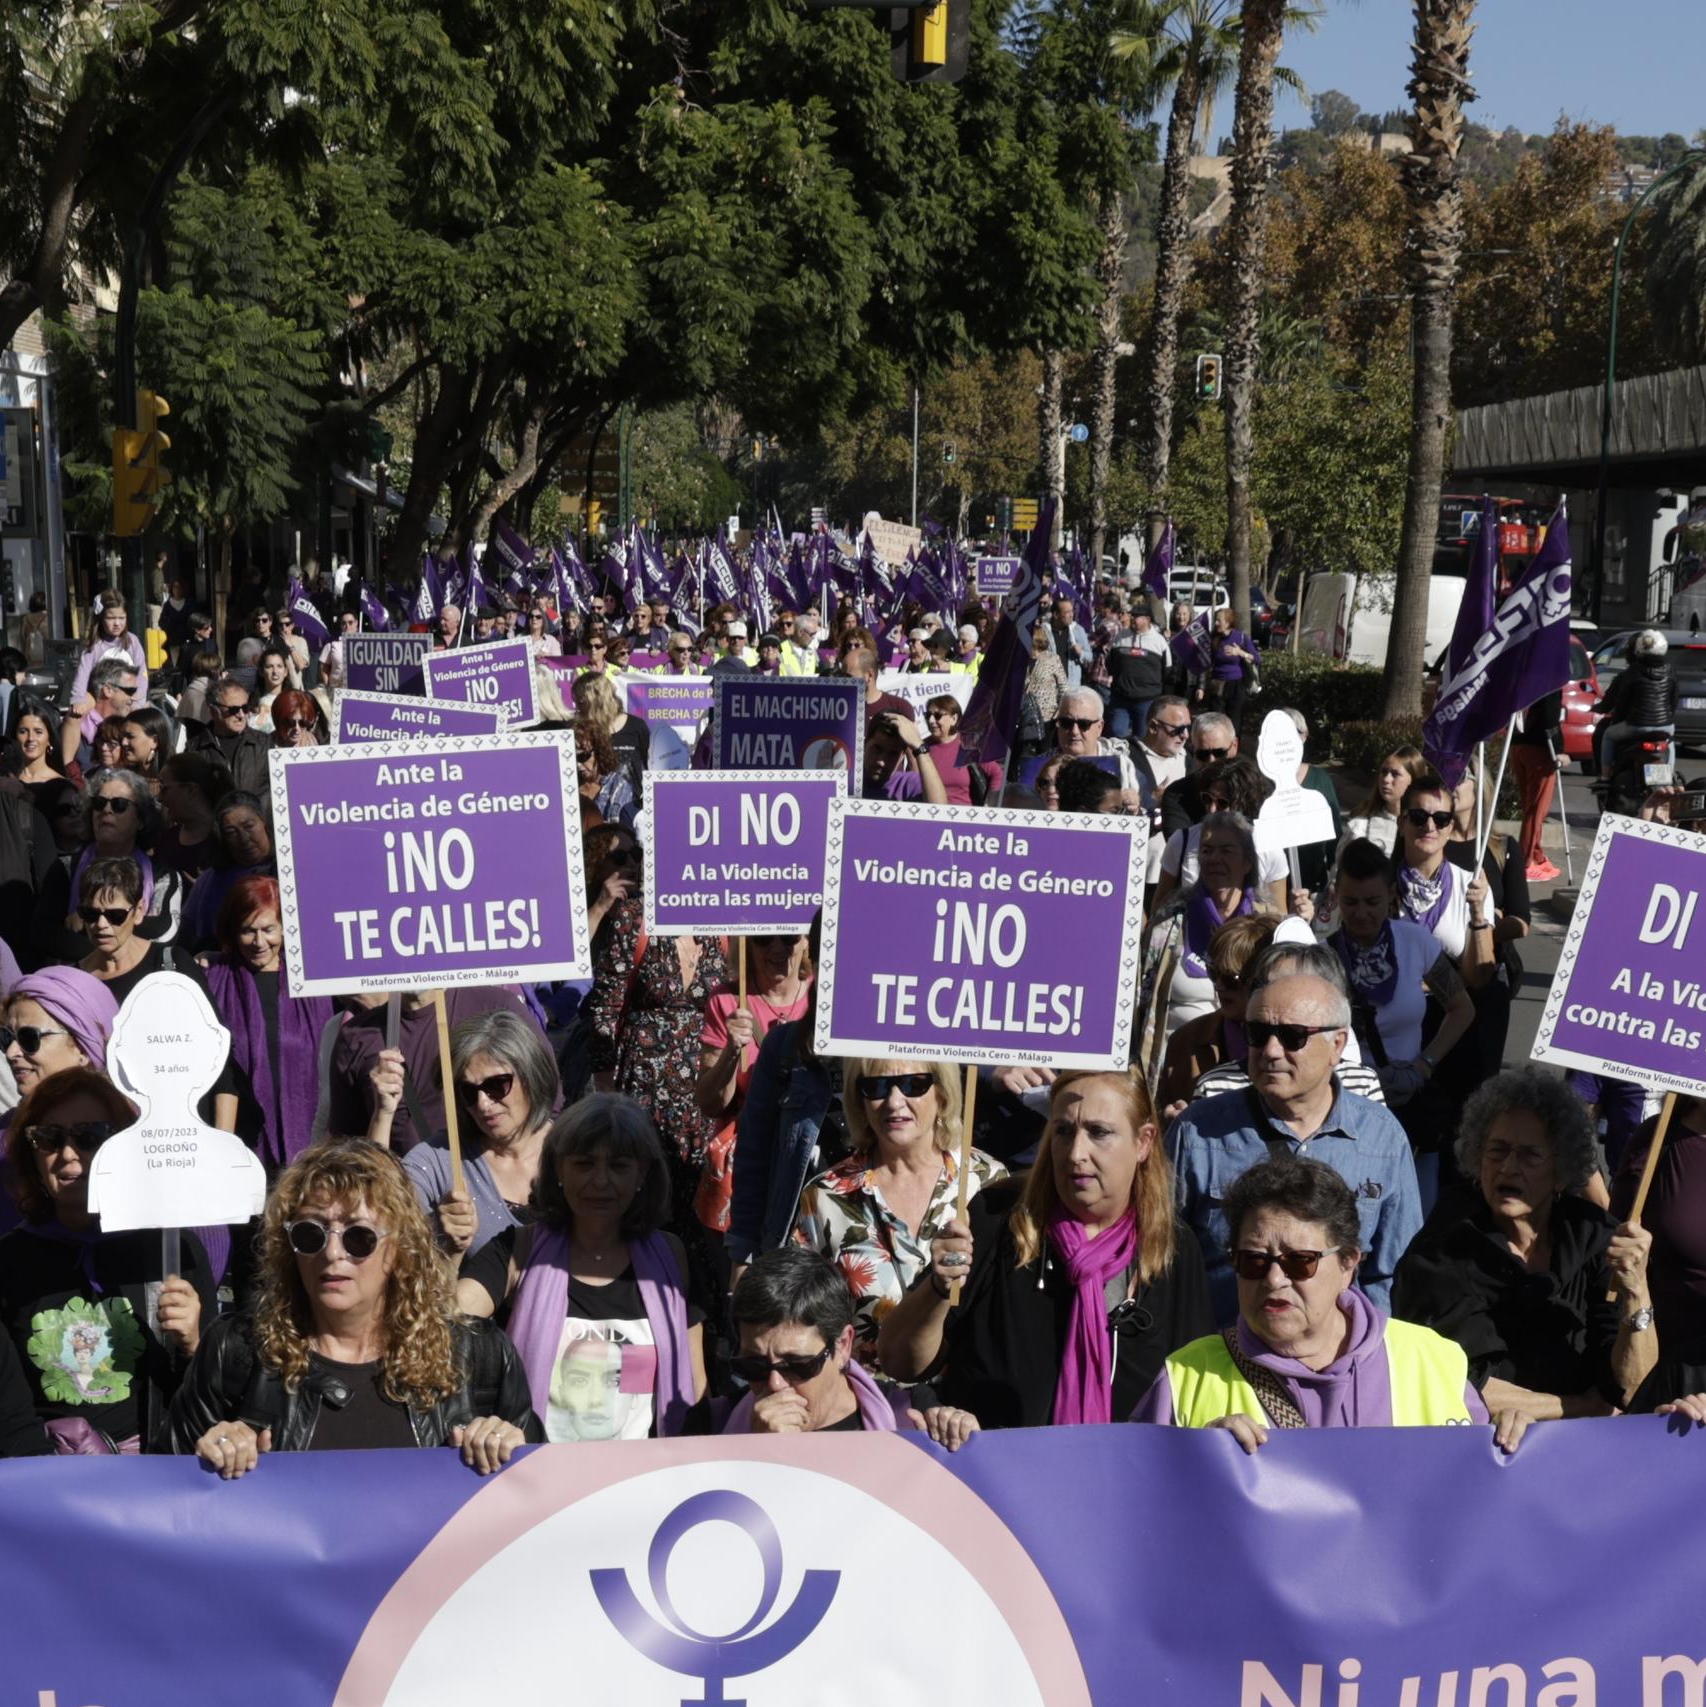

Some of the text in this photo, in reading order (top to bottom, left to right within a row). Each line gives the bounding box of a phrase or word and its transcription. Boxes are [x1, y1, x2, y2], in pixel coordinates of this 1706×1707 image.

[996, 562, 1011, 575] NO
[350, 641, 423, 666] IGUALDAD
[461, 651, 493, 666] Ante la
[374, 668, 400, 691] SIN
[434, 659, 524, 682] Violencia de Género
[648, 687, 705, 699] BRECHA de
[915, 682, 951, 697] tiene
[391, 708, 441, 725] Ante la
[648, 708, 690, 720] BRECHA
[731, 694, 849, 721] EL MACHISMO
[346, 723, 411, 741] Violencia
[730, 732, 795, 766] MATA
[376, 760, 463, 786] Ante la
[300, 791, 549, 825] Violencia de Género
[689, 792, 801, 846] DI NO
[937, 829, 1029, 856] Ante la
[384, 827, 475, 893] ¡NO
[681, 863, 809, 880] A la Violencia
[853, 859, 1114, 898] Violencia de Género
[658, 889, 751, 907] contra las
[1639, 883, 1699, 951] DI
[334, 898, 541, 960] TE CALLES!
[933, 898, 1027, 968] ¡NO
[361, 968, 519, 987] Plataforma Violencia Cero Málaga
[1611, 968, 1631, 993] A
[1638, 972, 1663, 1000] la
[872, 973, 1085, 1037] TE CALLES!
[1566, 1003, 1656, 1040] contra
[1661, 1018, 1701, 1050] las
[147, 1034, 193, 1044] SALWA Z.
[888, 1044, 1053, 1064] Plataforma Violencia Cero Málaga
[154, 1063, 189, 1074] 34 años
[1602, 1062, 1651, 1081] Plataforma
[1653, 1073, 1694, 1091] Violencia
[141, 1127, 198, 1138] 08/07/2023
[144, 1142, 198, 1154] LOGROÑO
[147, 1157, 195, 1169] (La Rioja)
